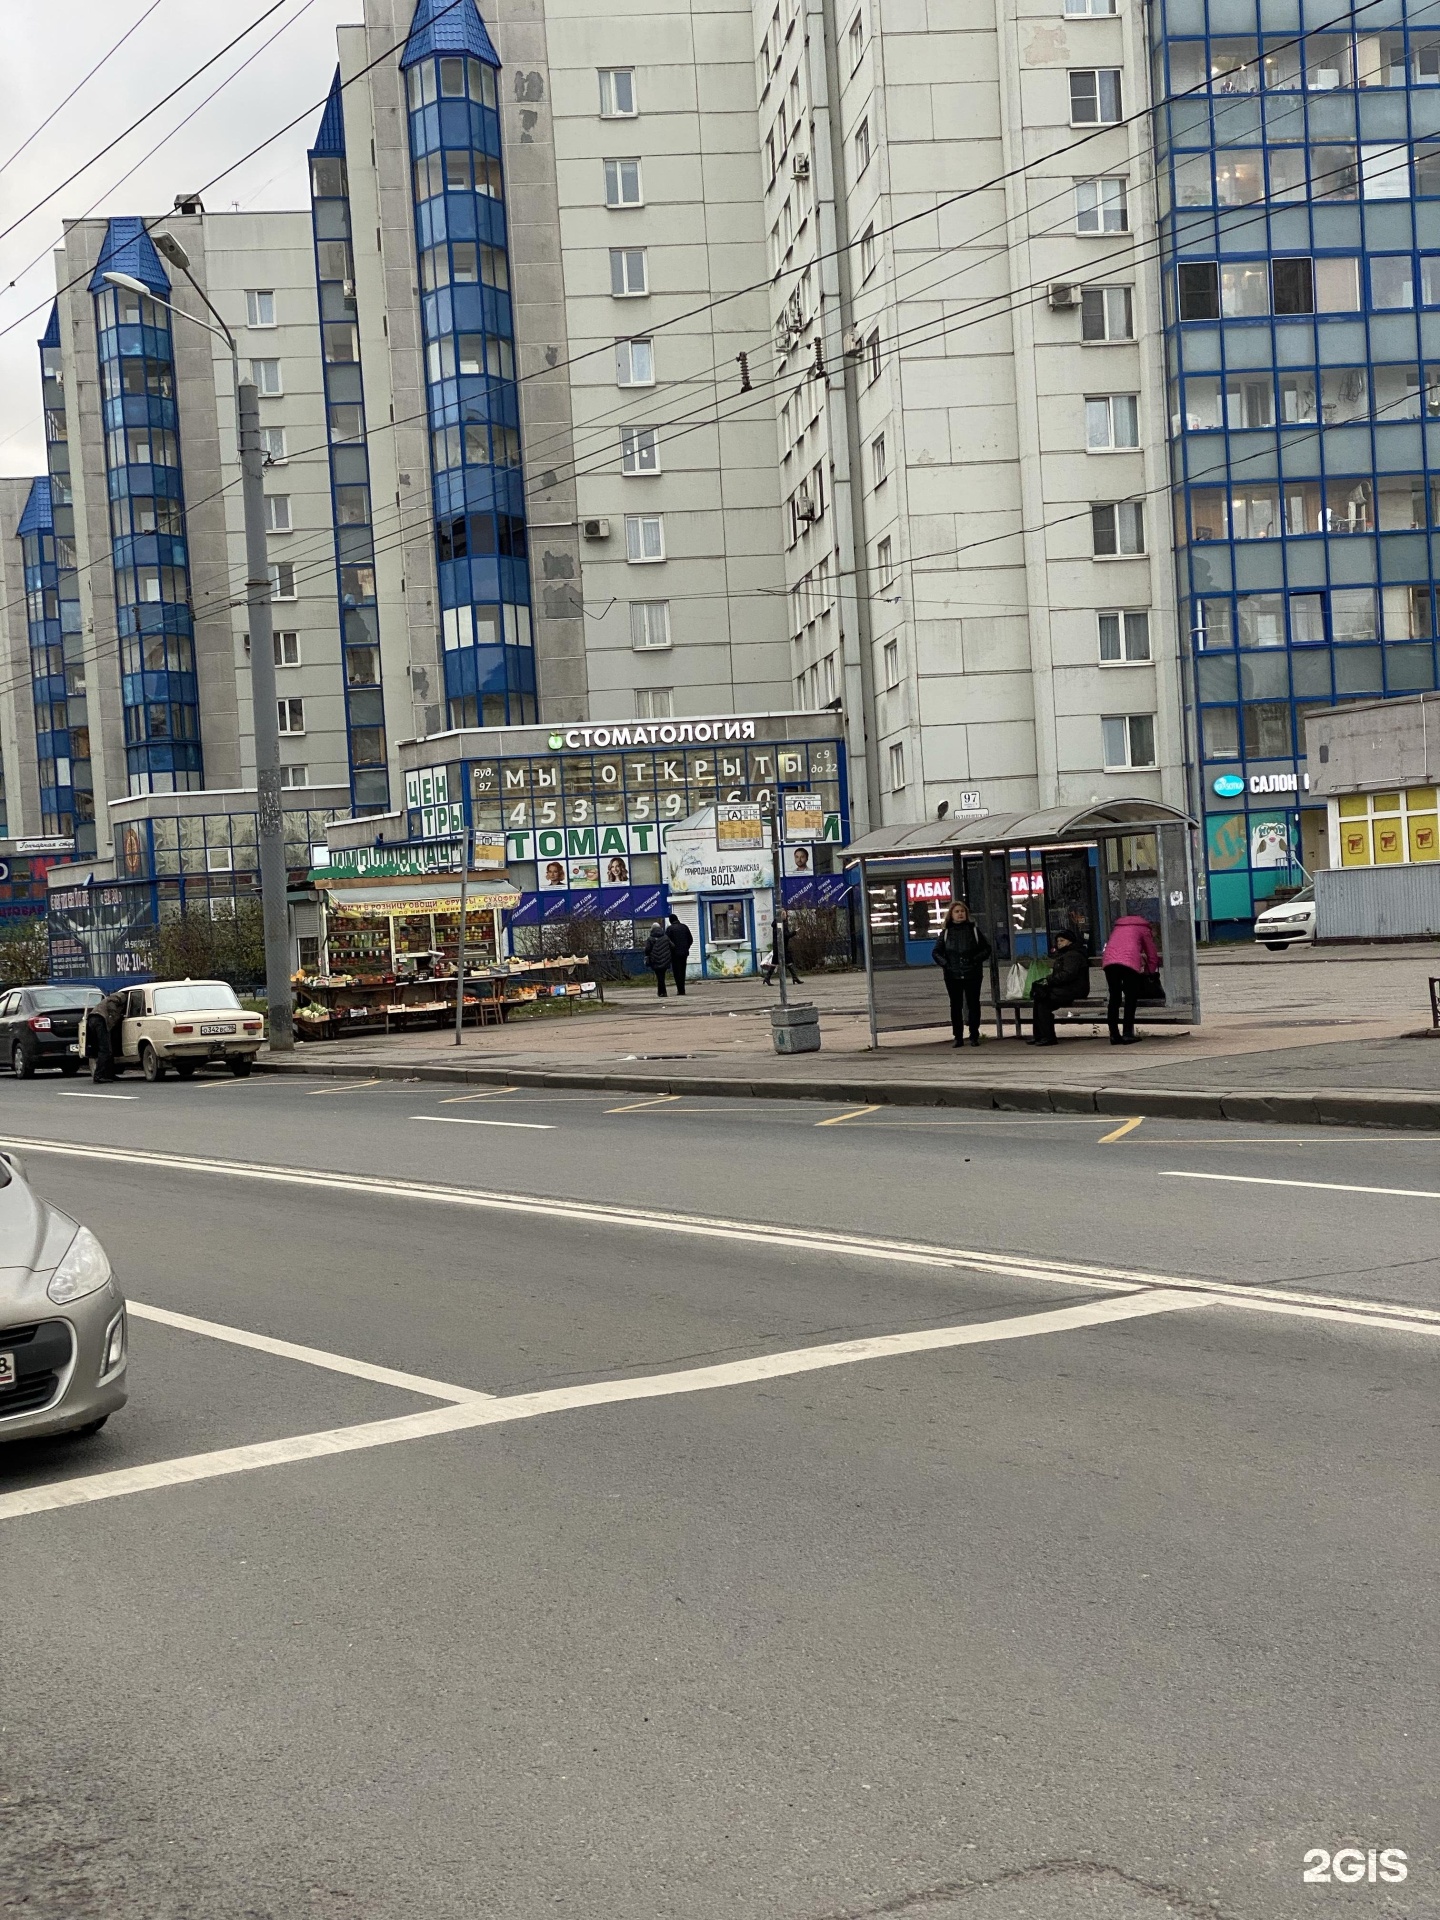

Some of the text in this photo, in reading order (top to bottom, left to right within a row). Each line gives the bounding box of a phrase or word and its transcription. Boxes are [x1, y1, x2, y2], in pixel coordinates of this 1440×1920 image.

[565, 720, 756, 749] СТОМАТОЛОГИЯ
[823, 749, 830, 759] 9
[473, 767, 495, 779] Буд.
[505, 754, 803, 789] МЫ ОТКРЫТЫ
[810, 763, 838, 774] до 22
[478, 781, 492, 792] 97
[1249, 773, 1298, 794] САЛОН
[408, 775, 447, 809] ЦЕН
[963, 793, 977, 804] 97
[423, 804, 464, 836] ТРЫ
[684, 863, 760, 876] ПРИРОДНАЯ АРТЕЗИАНСКАЯ
[711, 873, 736, 886] ВОДА
[907, 880, 951, 898] ТАБАК
[371, 901, 407, 910] РОЗНИЦУ
[408, 900, 438, 909] ОВОЩИ
[580, 892, 592, 905] FLOW
[603, 891, 630, 916] РЕСТАВРАЦИЯ
